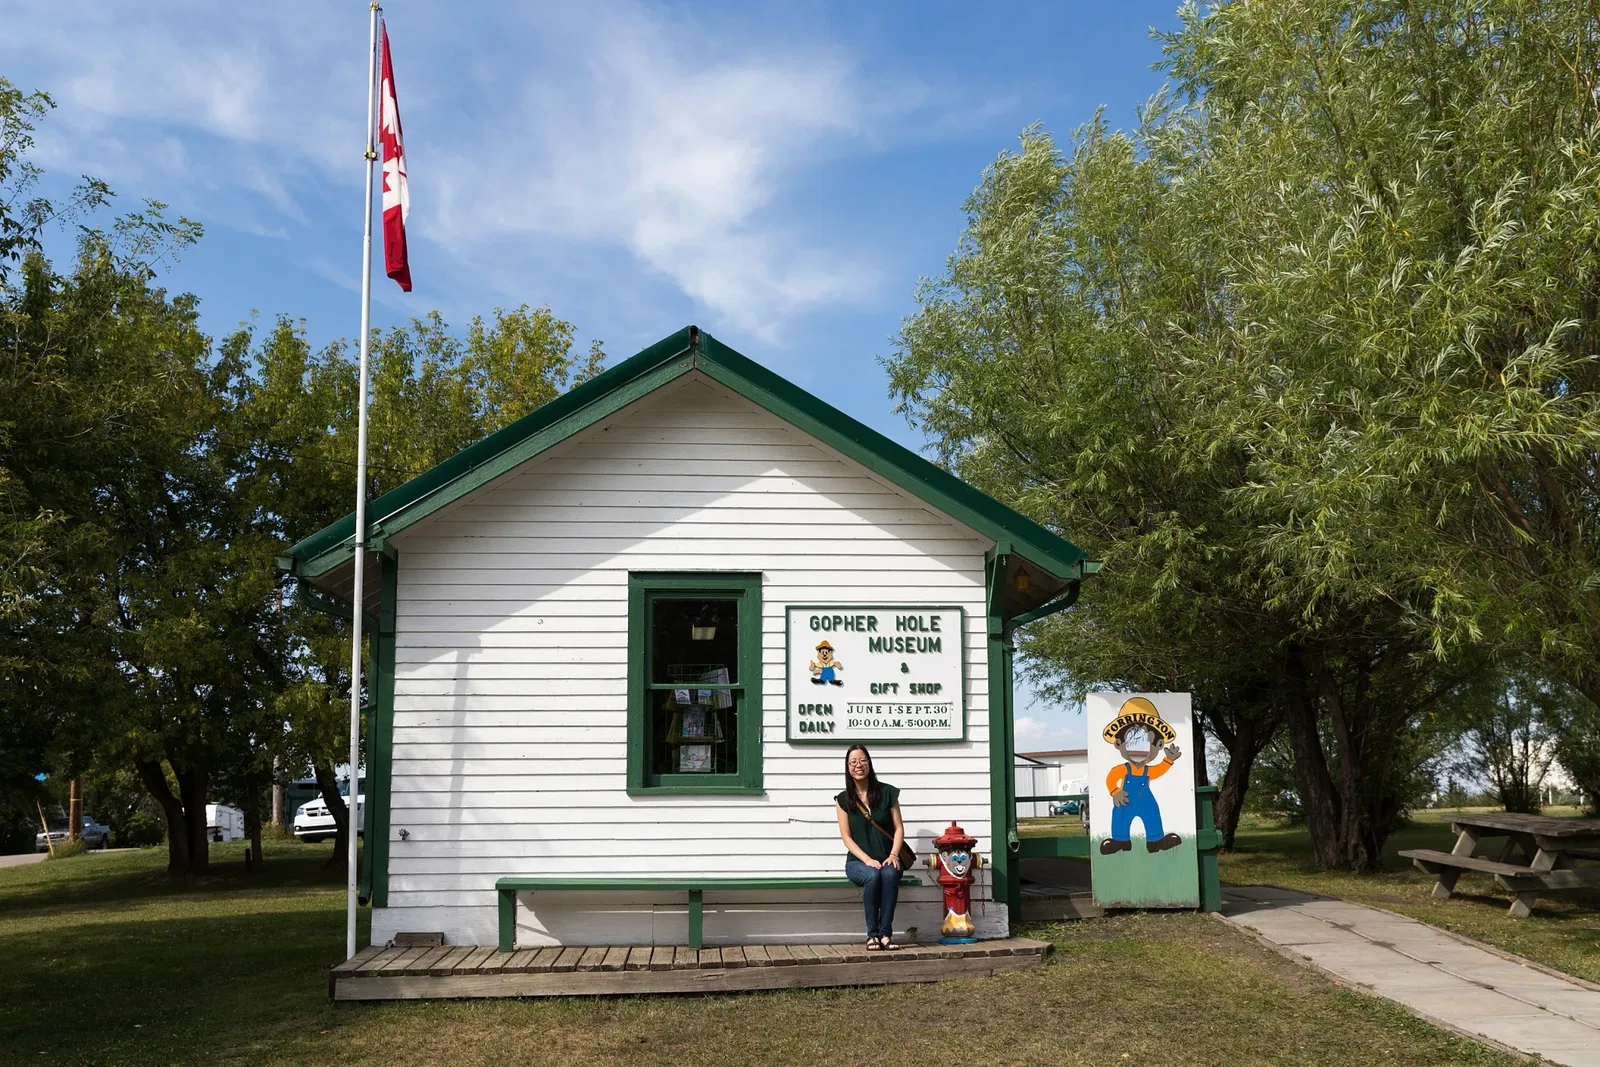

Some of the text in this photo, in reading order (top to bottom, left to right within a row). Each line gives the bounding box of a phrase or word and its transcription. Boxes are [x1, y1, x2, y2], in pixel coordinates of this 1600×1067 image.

[809, 615, 942, 632] GOPHER HOLE
[868, 636, 942, 653] MUSEUM
[900, 662, 910, 673] &
[870, 683, 942, 695] GIFT SHOP
[798, 703, 833, 716] OPEN
[847, 705, 882, 714] JUNE
[799, 720, 836, 733] DAILY
[1104, 713, 1175, 740] TORRINGTON
